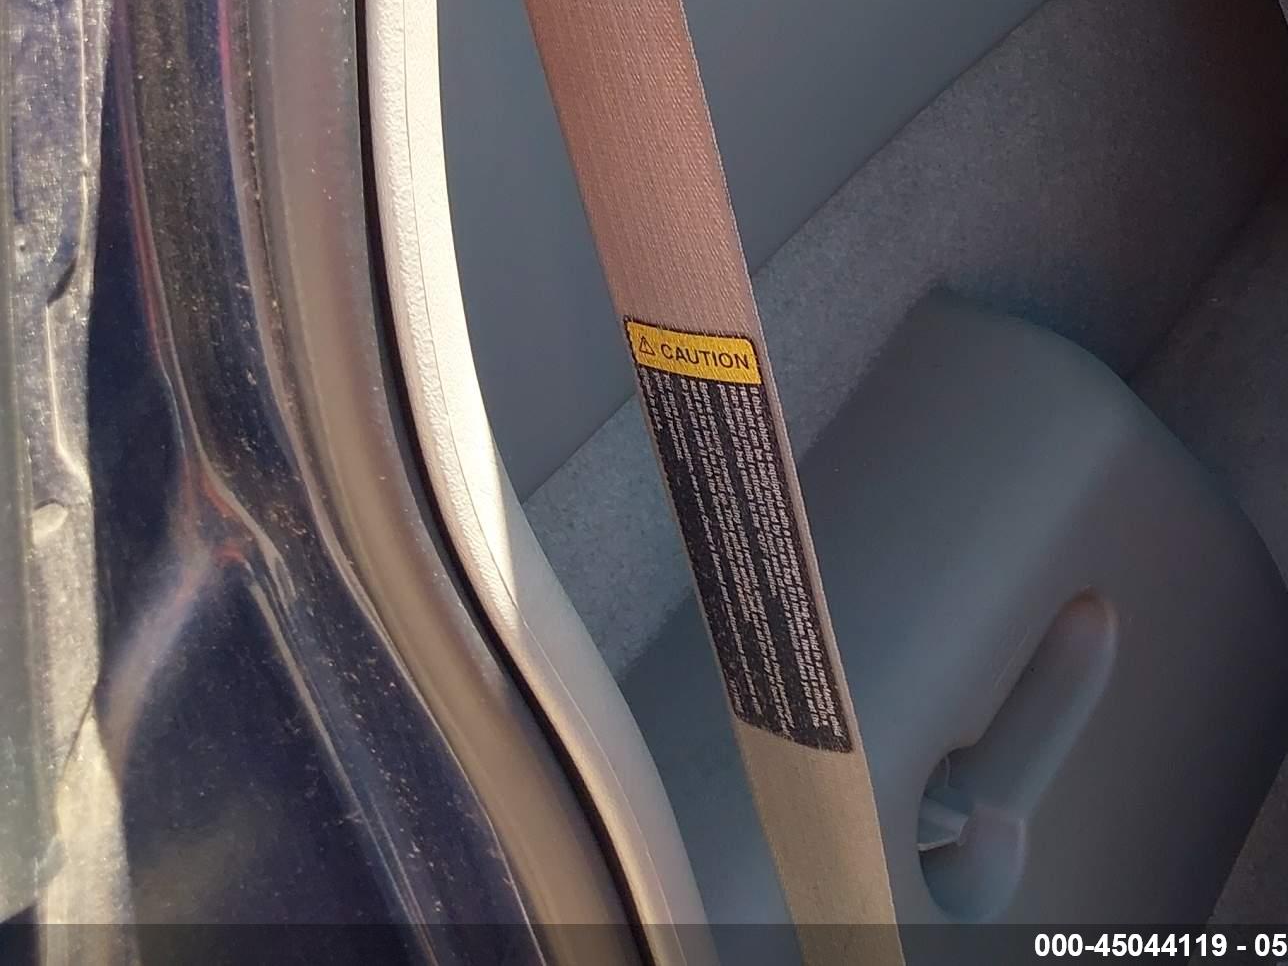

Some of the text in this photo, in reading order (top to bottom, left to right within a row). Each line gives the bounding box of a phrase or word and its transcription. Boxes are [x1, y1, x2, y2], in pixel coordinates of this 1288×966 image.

[660, 344, 750, 370] CAUTION
[716, 384, 736, 433] passenger
[738, 386, 755, 427] restraint
[740, 470, 754, 500] switch
[755, 461, 770, 488] badly
[762, 489, 778, 522] injured
[726, 385, 748, 437] rear-facing
[742, 439, 754, 463] child
[748, 464, 764, 504] restraint
[765, 532, 777, 555] front
[786, 618, 801, 651] vehicle
[794, 651, 808, 680] unless
[755, 530, 768, 557] "OFF"
[756, 416, 772, 451] vehicle
[765, 463, 785, 507] equipped
[782, 537, 802, 585] passenger
[807, 628, 820, 651] child
[816, 668, 836, 715] rear-facing
[829, 715, 841, 736] child
[761, 558, 778, 598] position.
[801, 638, 813, 664] Never
[813, 688, 825, 710] child
